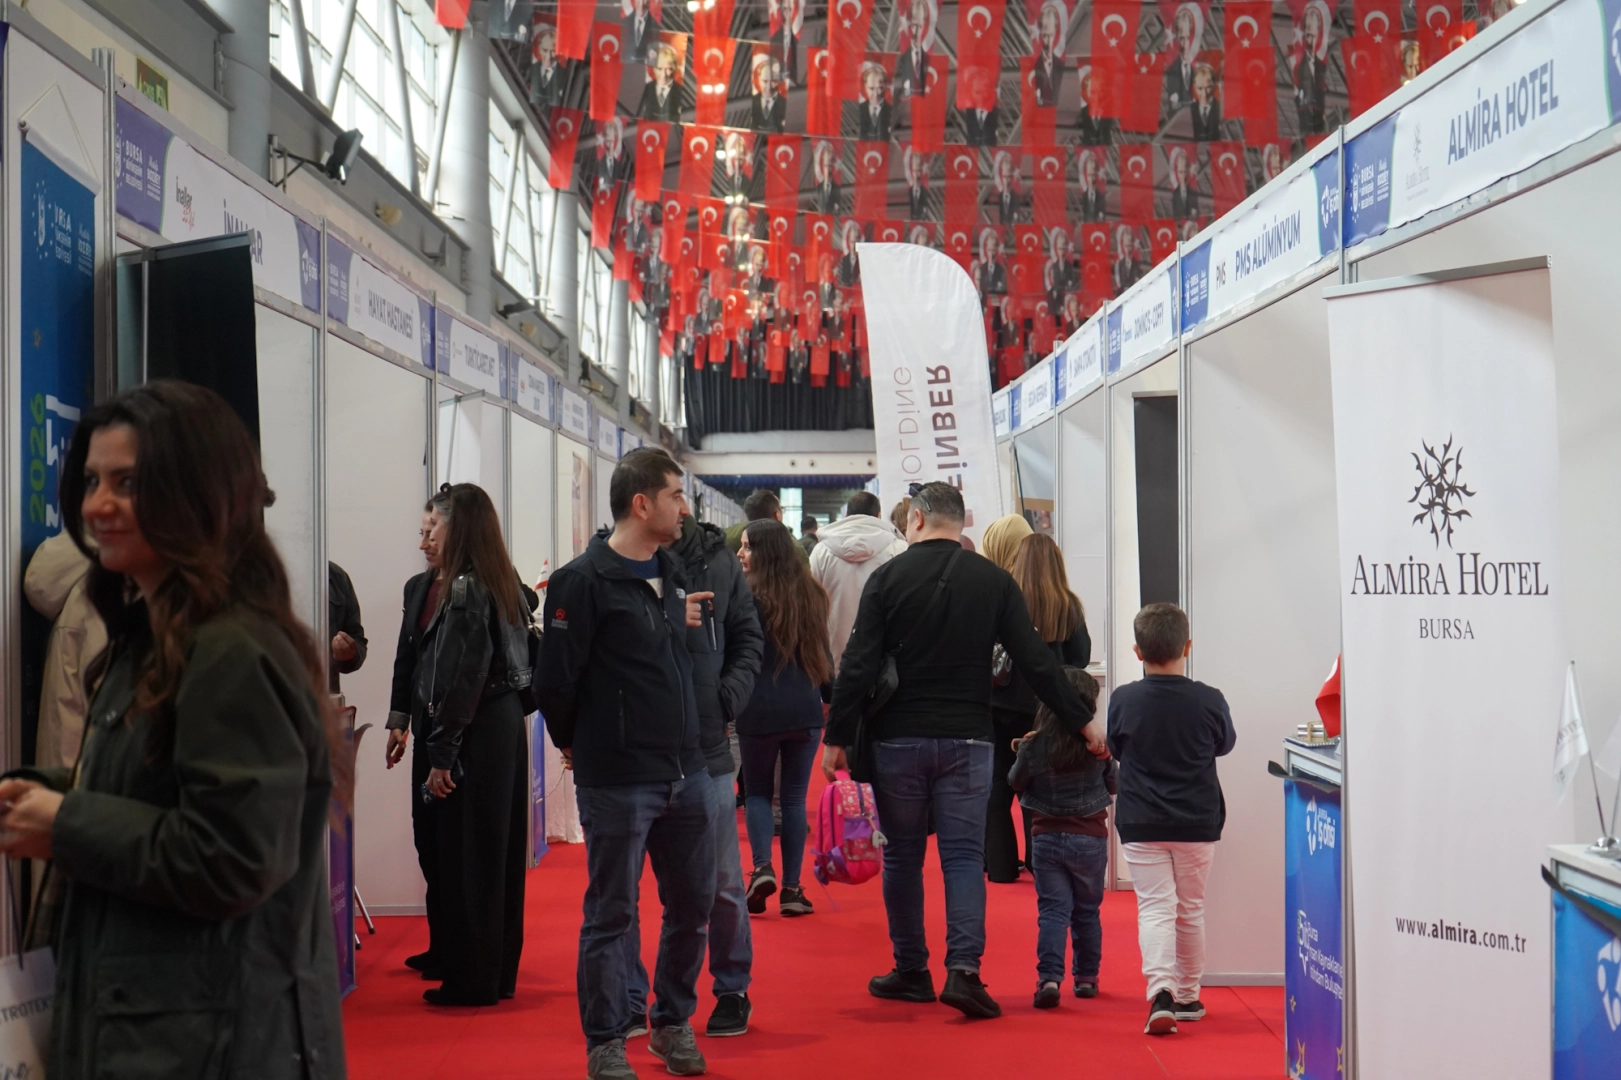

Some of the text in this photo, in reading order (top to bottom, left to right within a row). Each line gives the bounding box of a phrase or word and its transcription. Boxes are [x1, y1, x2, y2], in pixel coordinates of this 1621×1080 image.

[1447, 59, 1559, 165] ALMİRA HOTEL
[125, 140, 143, 165] BURSA
[1360, 163, 1374, 184] BURSA
[1234, 209, 1301, 281] PMS ALÜMİNYUM
[1216, 260, 1226, 291] PMS
[368, 288, 387, 325] HAYAT
[387, 300, 413, 340] HASTANESİ
[29, 392, 46, 525] 2026
[1350, 552, 1549, 596] ALMİRA HOTEL
[1418, 618, 1475, 640] BURSA
[1395, 917, 1527, 954] www.almira.com.tr
